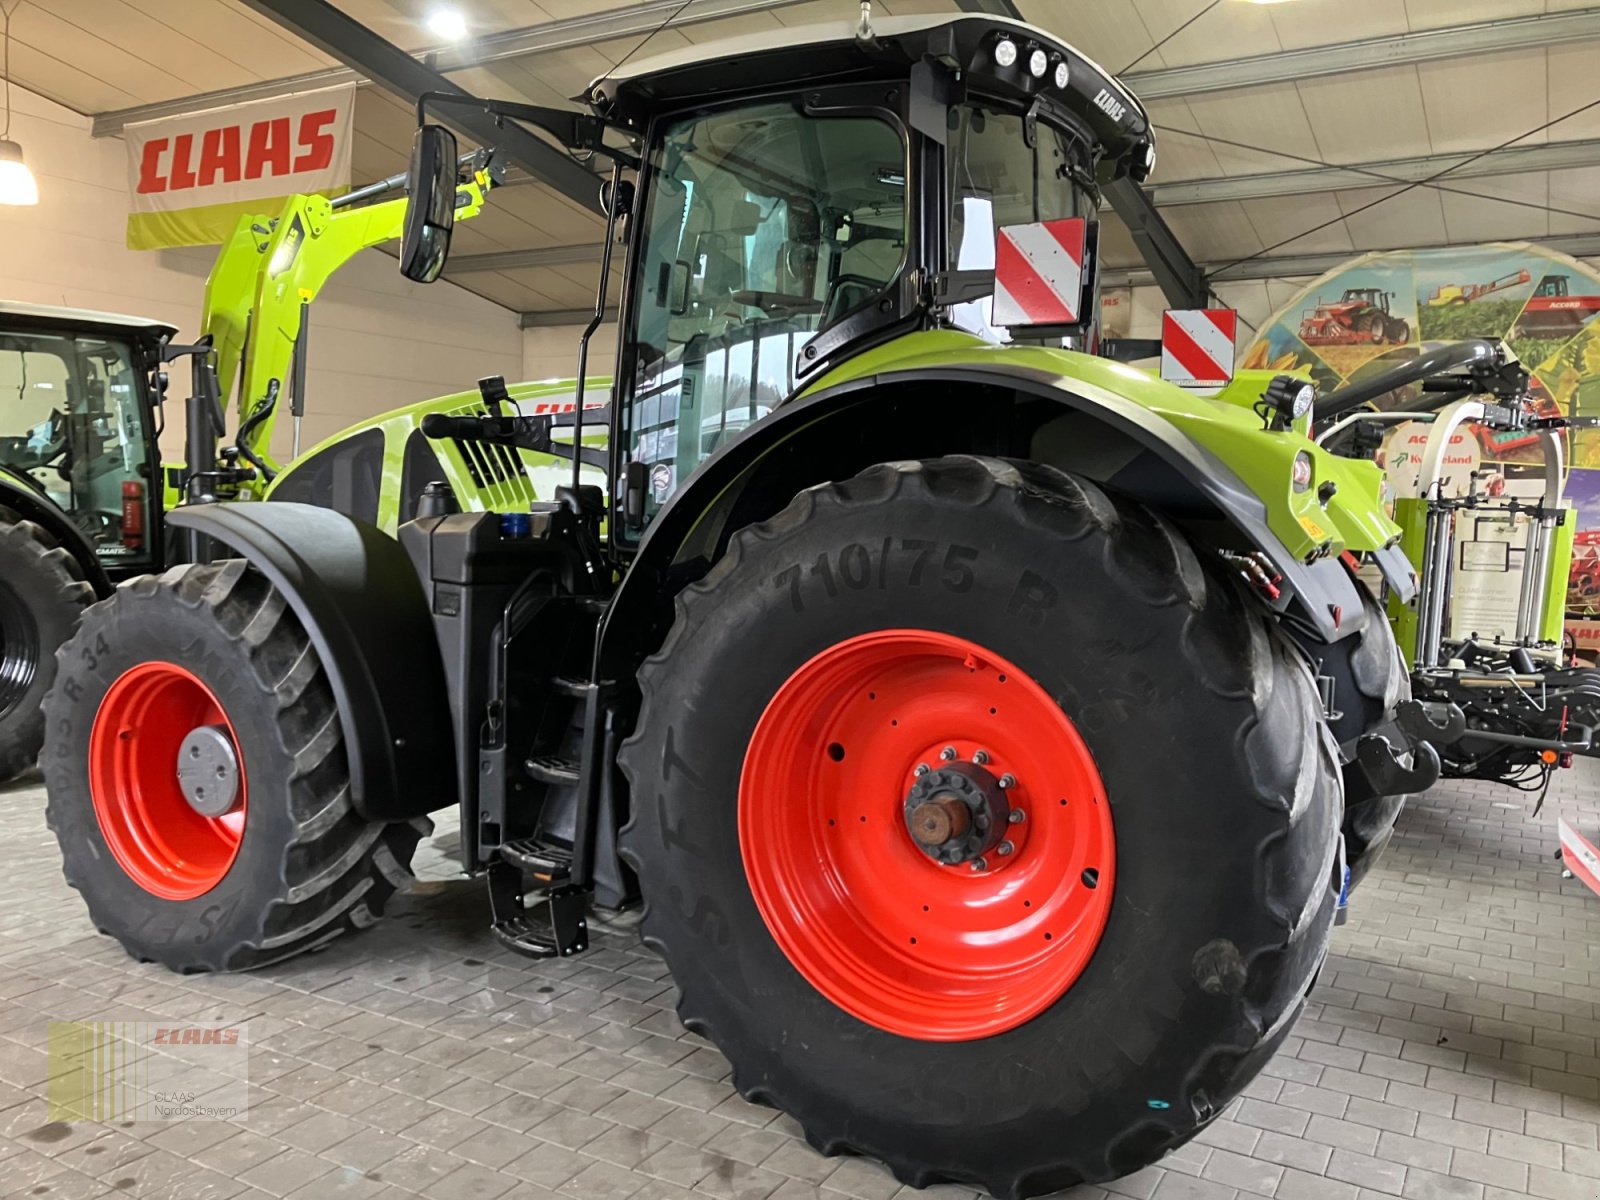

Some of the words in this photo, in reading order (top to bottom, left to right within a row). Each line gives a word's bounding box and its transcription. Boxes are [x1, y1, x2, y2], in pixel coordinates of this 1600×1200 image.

[1093, 88, 1126, 122] CLAAS
[137, 109, 336, 194] CLAAS
[1408, 435, 1464, 444] ACD
[774, 536, 979, 613] 710/75
[1006, 569, 1059, 628] R
